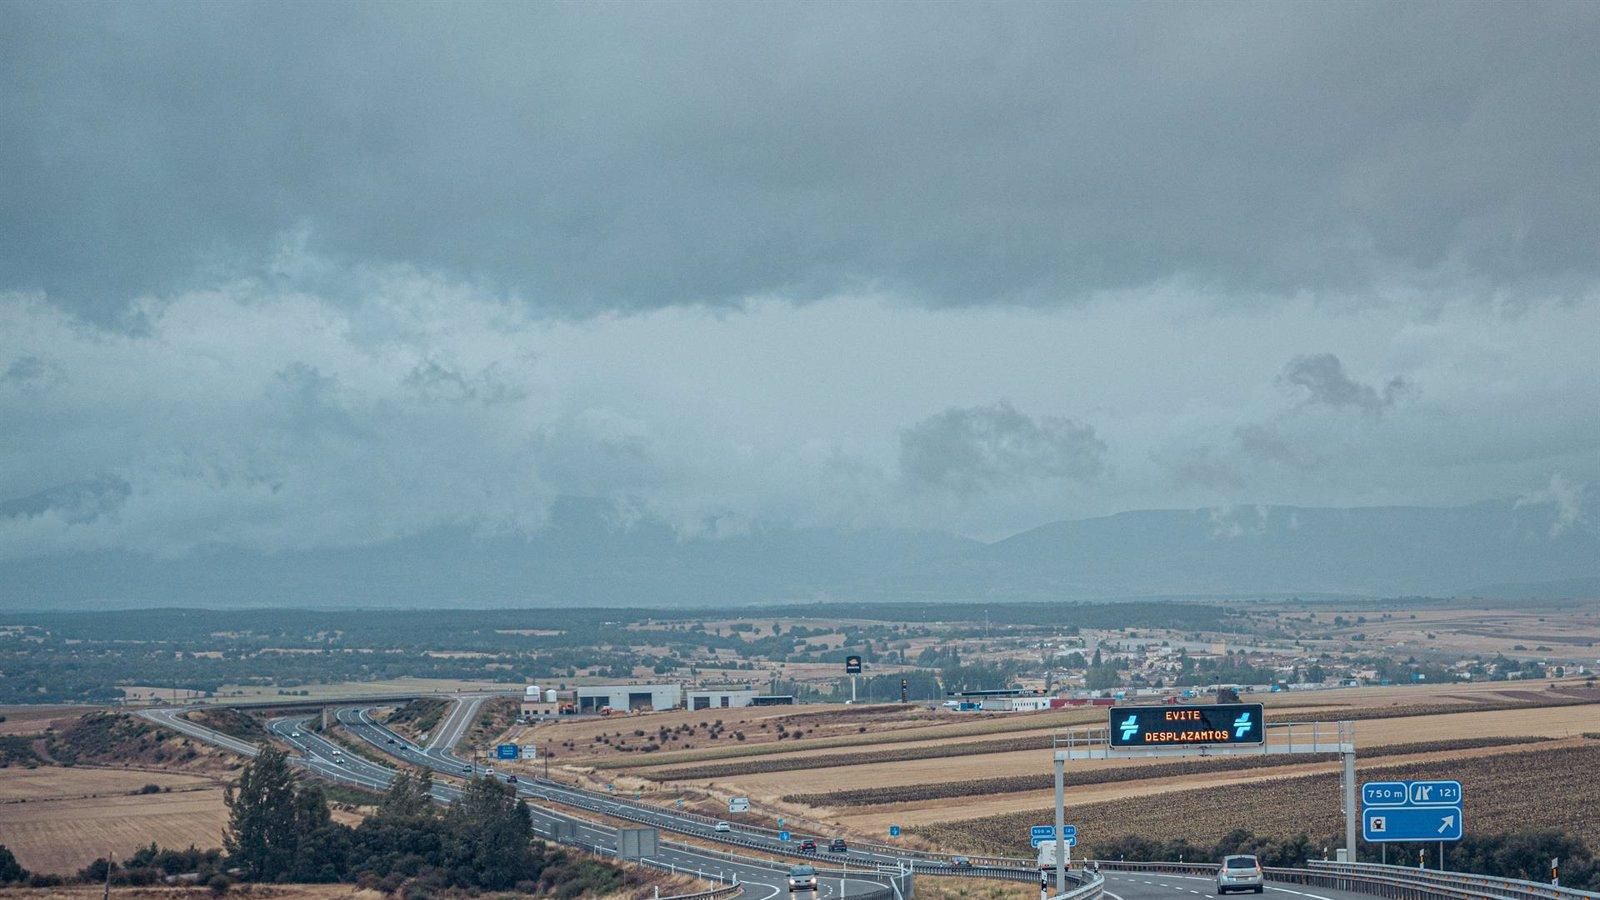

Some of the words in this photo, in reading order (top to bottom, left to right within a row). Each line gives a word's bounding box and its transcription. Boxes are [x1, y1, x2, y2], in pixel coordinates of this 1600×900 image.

[1165, 710, 1200, 720] EVITE
[1145, 730, 1229, 741] DESPLAZAMTOS
[1368, 789, 1391, 798] 750
[1394, 790, 1403, 798] m
[1439, 788, 1456, 797] 121
